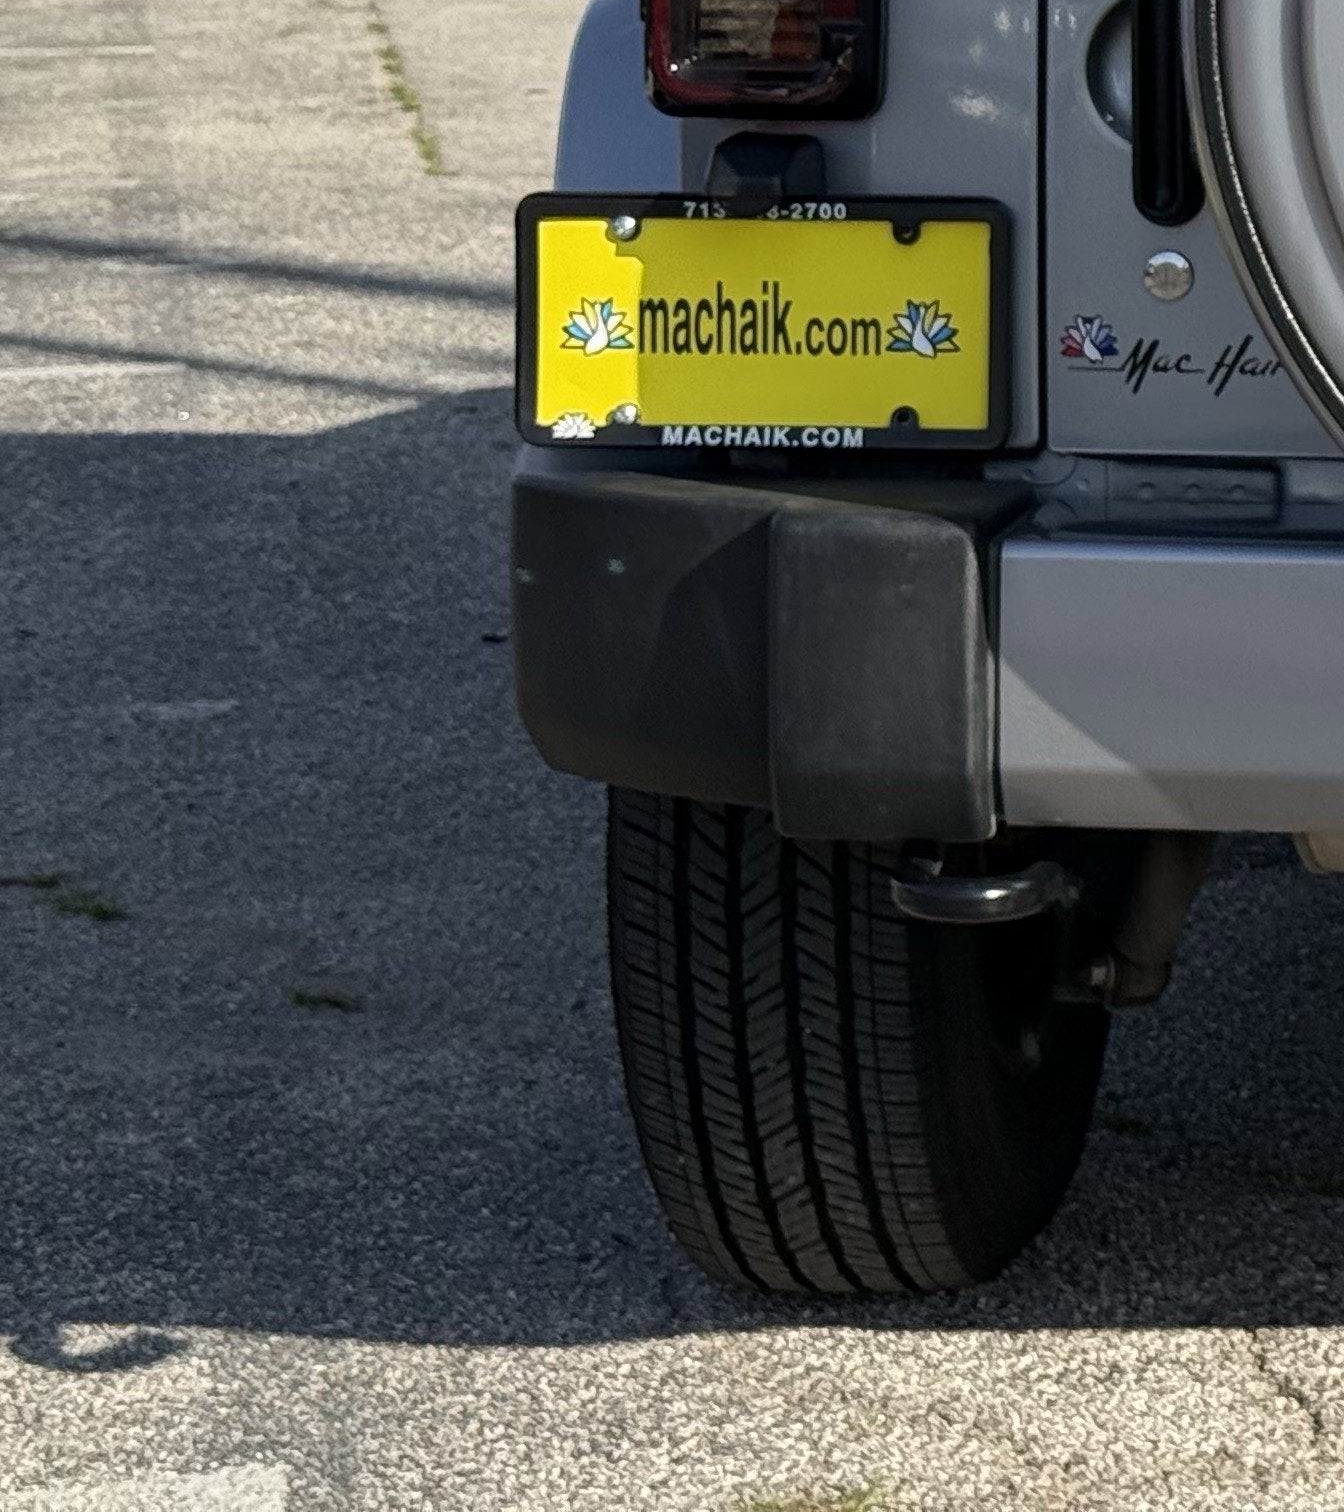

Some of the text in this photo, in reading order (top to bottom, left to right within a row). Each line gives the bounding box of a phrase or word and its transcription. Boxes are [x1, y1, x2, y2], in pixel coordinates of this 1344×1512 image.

[637, 281, 882, 355] machaik.com
[1121, 337, 1204, 395] Mac
[661, 425, 864, 449] MACHAIK.COM
